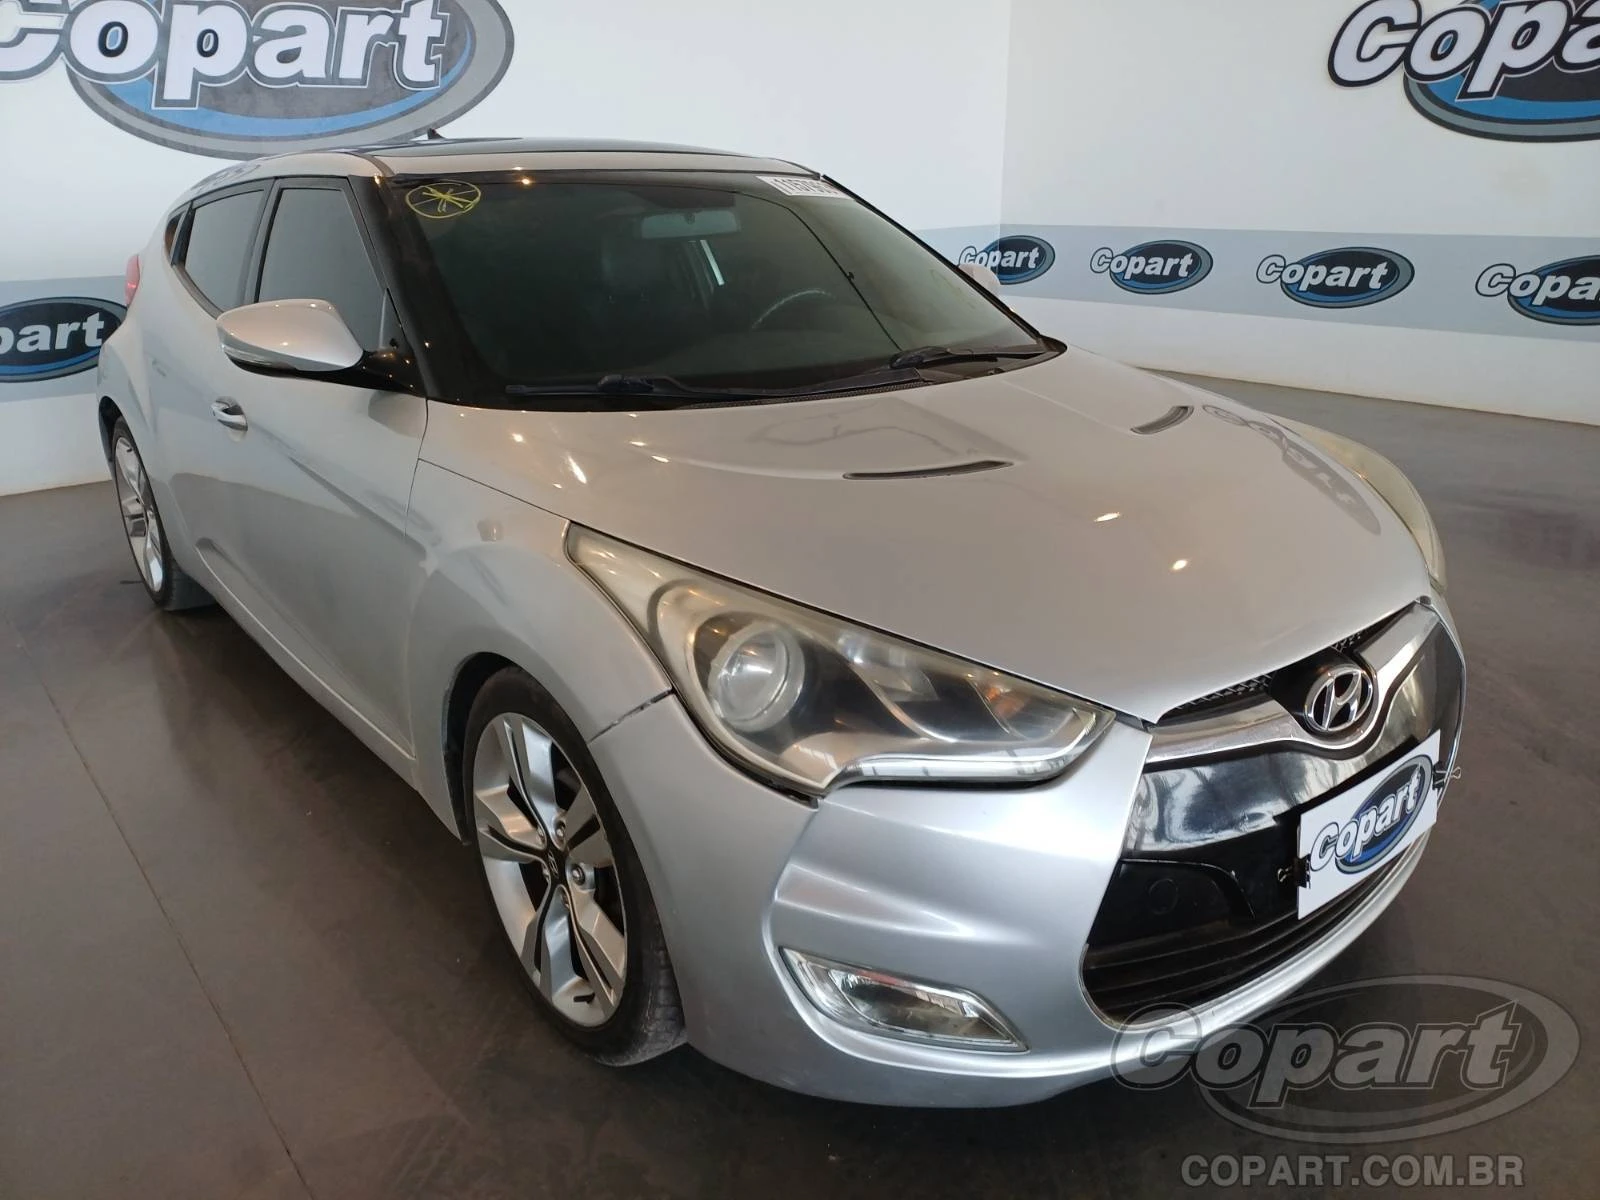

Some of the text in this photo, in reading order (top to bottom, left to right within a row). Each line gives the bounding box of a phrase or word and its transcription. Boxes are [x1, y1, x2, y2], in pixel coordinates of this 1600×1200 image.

[1090, 246, 1193, 281] Copart
[1256, 254, 1388, 292] Copart
[1310, 763, 1421, 871] Copart
